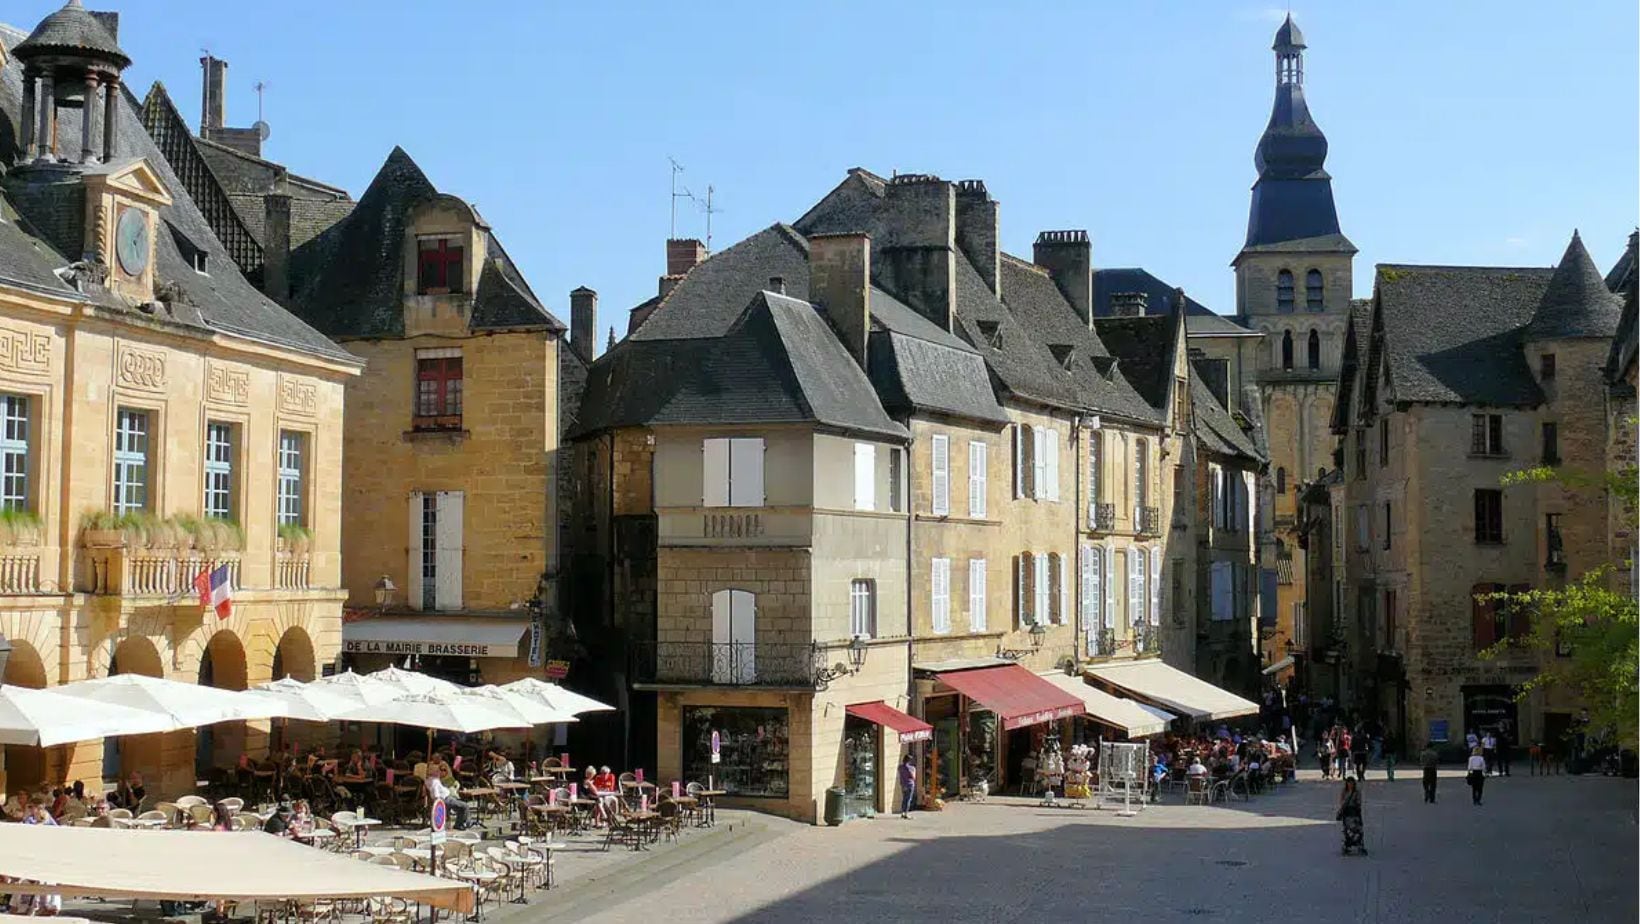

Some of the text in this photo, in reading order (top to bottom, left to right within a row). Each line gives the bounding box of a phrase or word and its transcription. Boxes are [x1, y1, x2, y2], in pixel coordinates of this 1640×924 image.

[346, 641, 489, 656] DE LA MAIRIE BRASSERIE
